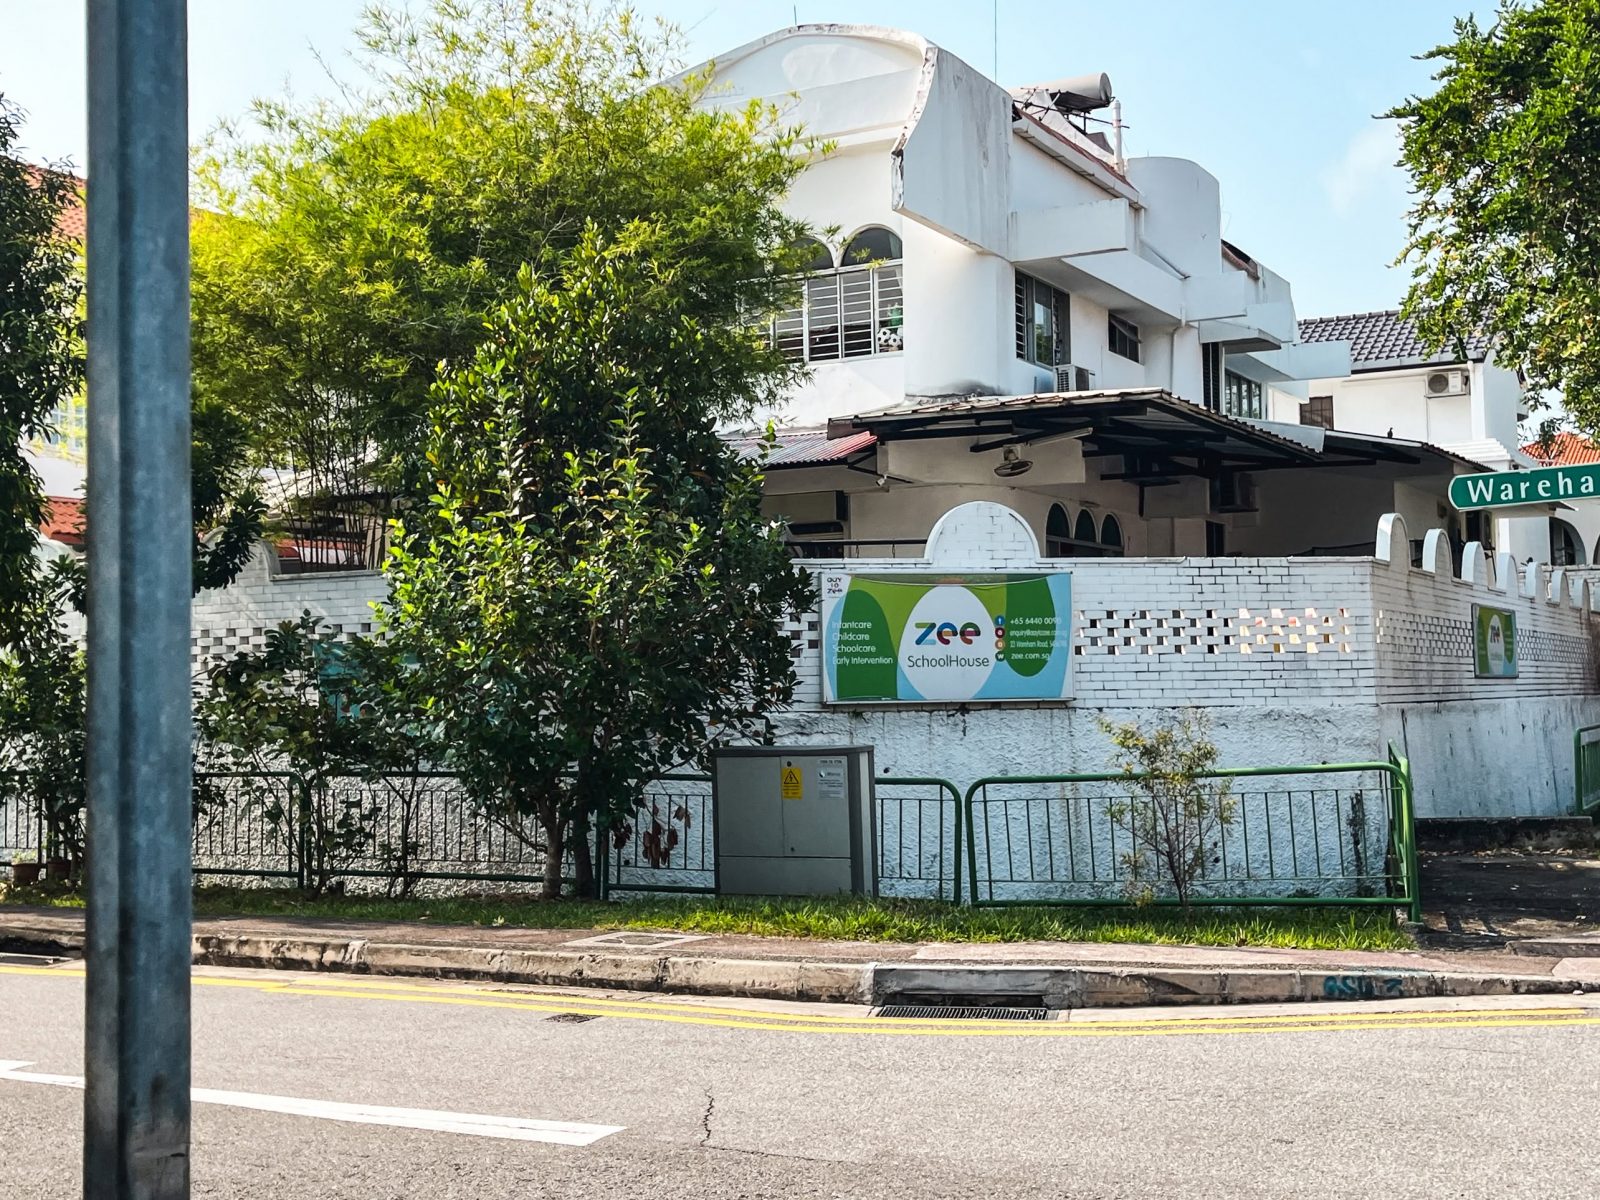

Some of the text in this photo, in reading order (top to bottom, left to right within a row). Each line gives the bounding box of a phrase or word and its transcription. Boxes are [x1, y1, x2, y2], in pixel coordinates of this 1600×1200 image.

[832, 621, 872, 629] Infantcare
[1010, 617, 1023, 625] +65
[1025, 617, 1043, 625] 6440
[832, 632, 870, 641] Childcare
[915, 622, 981, 645] zee
[832, 644, 876, 653] Schoolcare
[832, 656, 894, 667] Early Intervention
[907, 655, 990, 668] SchoolHouse
